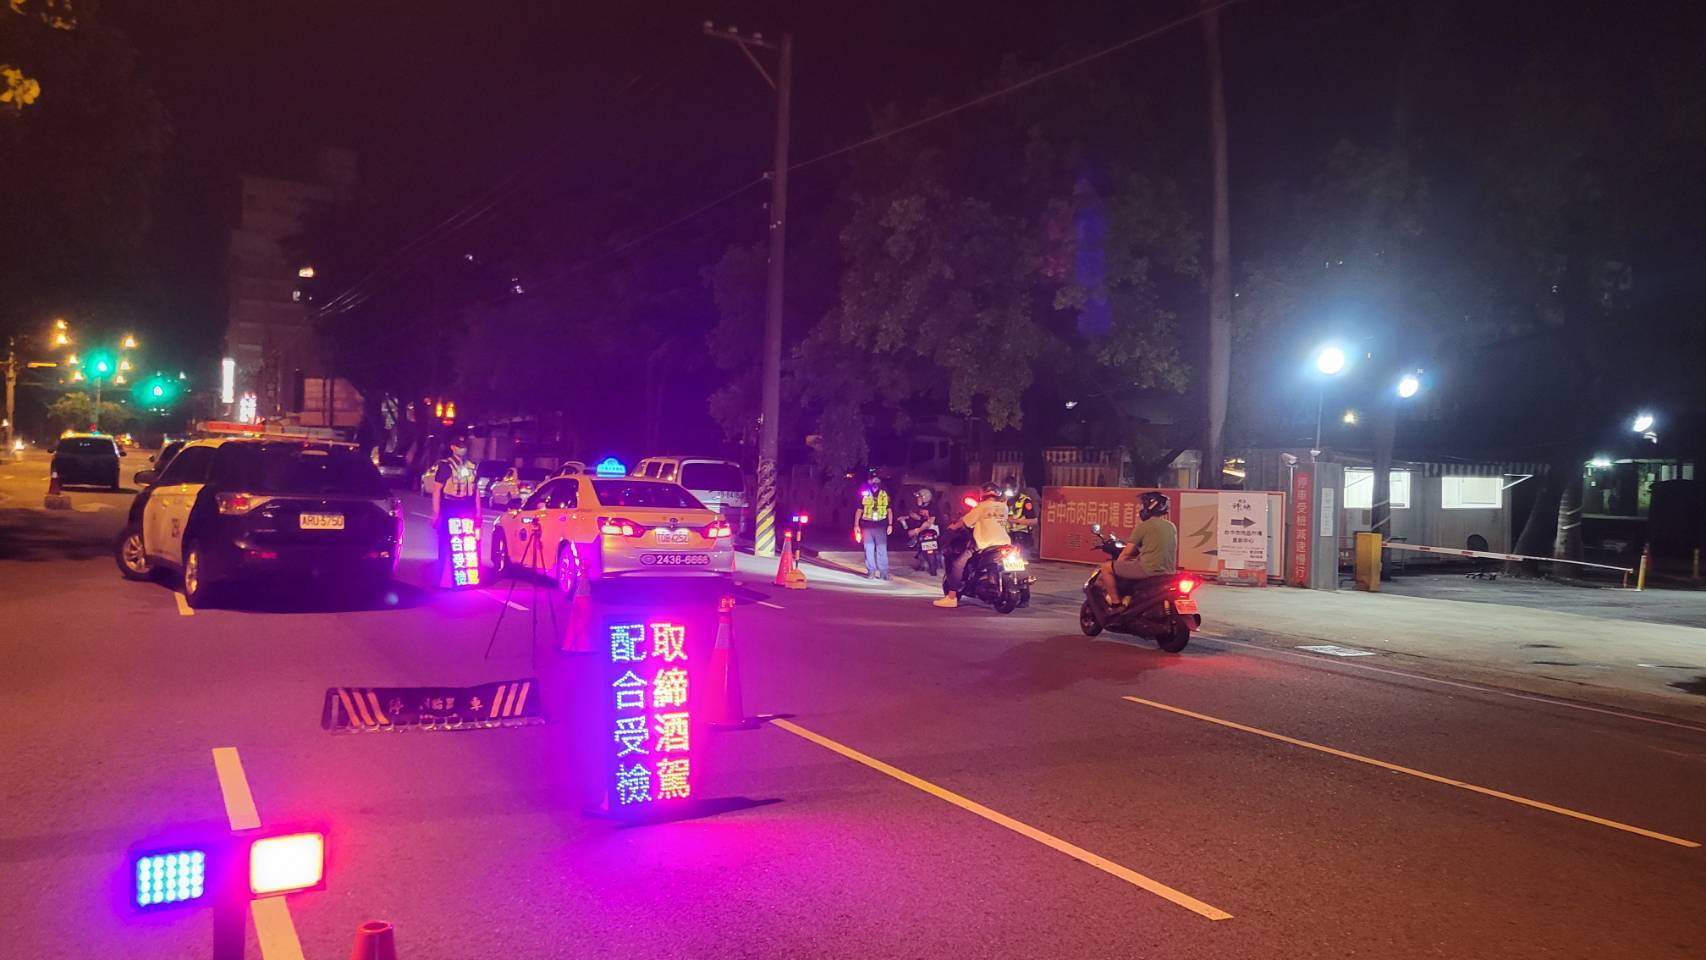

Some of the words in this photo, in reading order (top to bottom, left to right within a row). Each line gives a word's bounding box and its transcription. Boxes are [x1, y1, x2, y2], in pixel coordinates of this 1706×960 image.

[1047, 500, 1120, 528] 台中市肉品市場
[609, 624, 652, 805] 配合受檢
[650, 622, 691, 800] 取締酒駕
